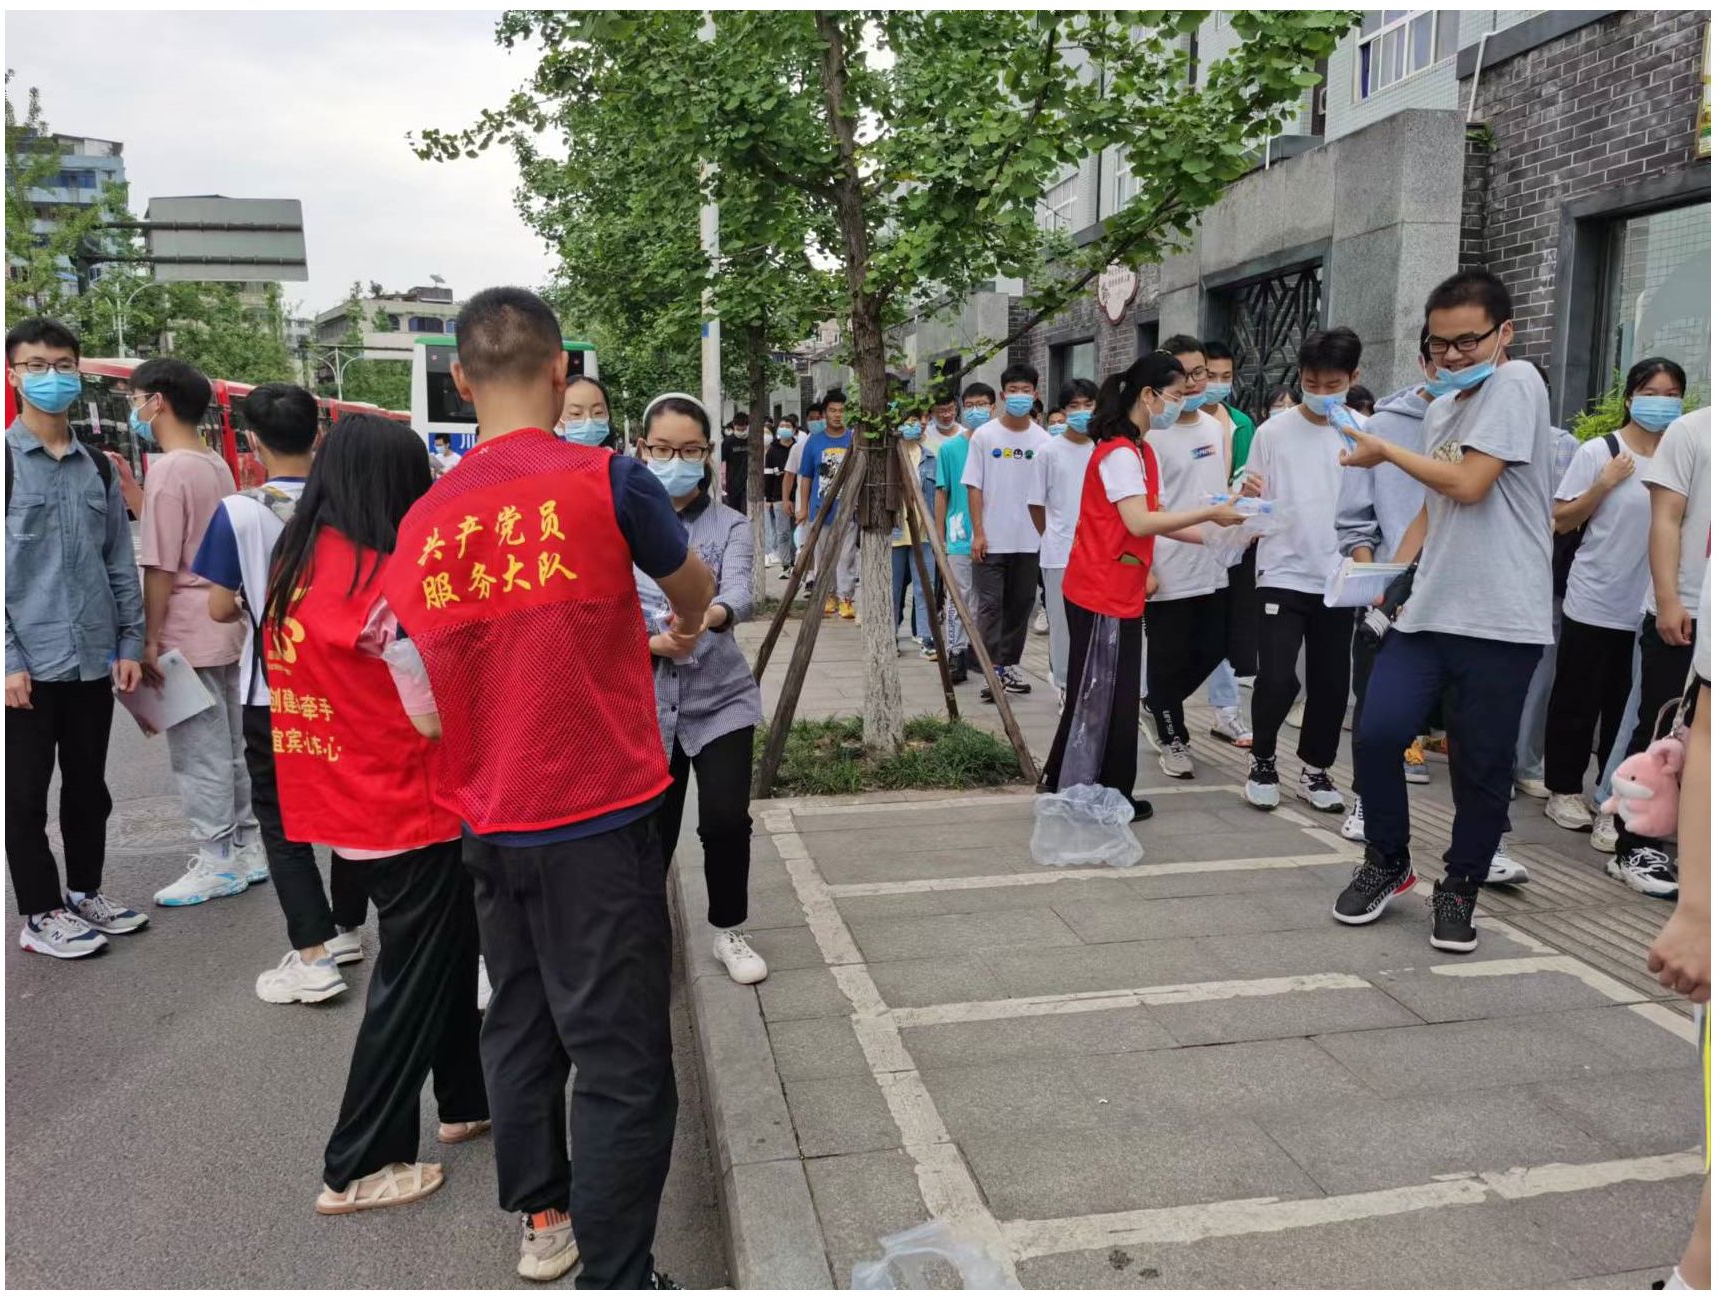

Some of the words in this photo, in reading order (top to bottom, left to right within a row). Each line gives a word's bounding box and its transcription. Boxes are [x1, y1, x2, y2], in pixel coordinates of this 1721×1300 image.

[417, 499, 566, 566] 共产党员
[422, 551, 578, 611] 服务大队
